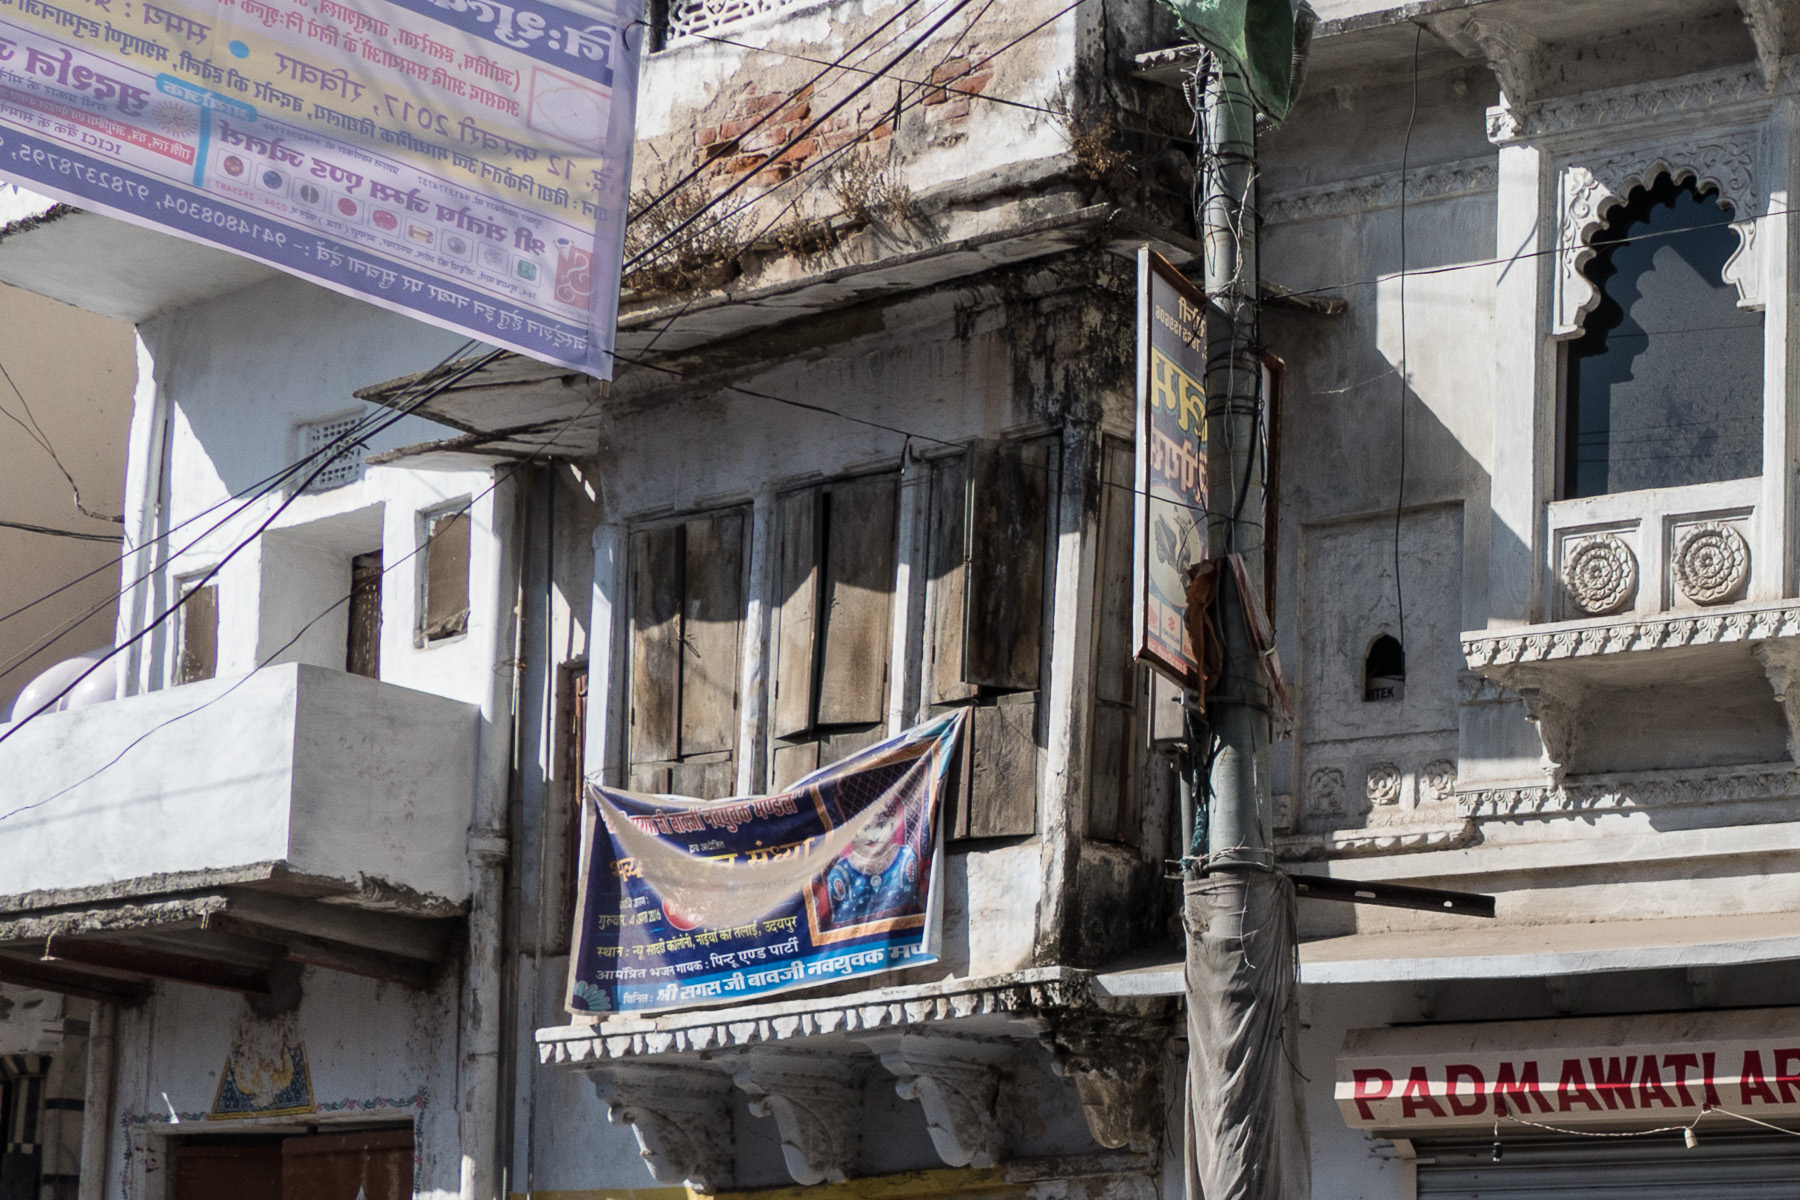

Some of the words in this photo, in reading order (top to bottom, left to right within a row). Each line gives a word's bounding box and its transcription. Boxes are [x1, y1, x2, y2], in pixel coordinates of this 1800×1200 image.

[721, 972, 746, 992] जी
[807, 946, 885, 976] नवयुवक
[1352, 1050, 1719, 1121] PADMAWATI
